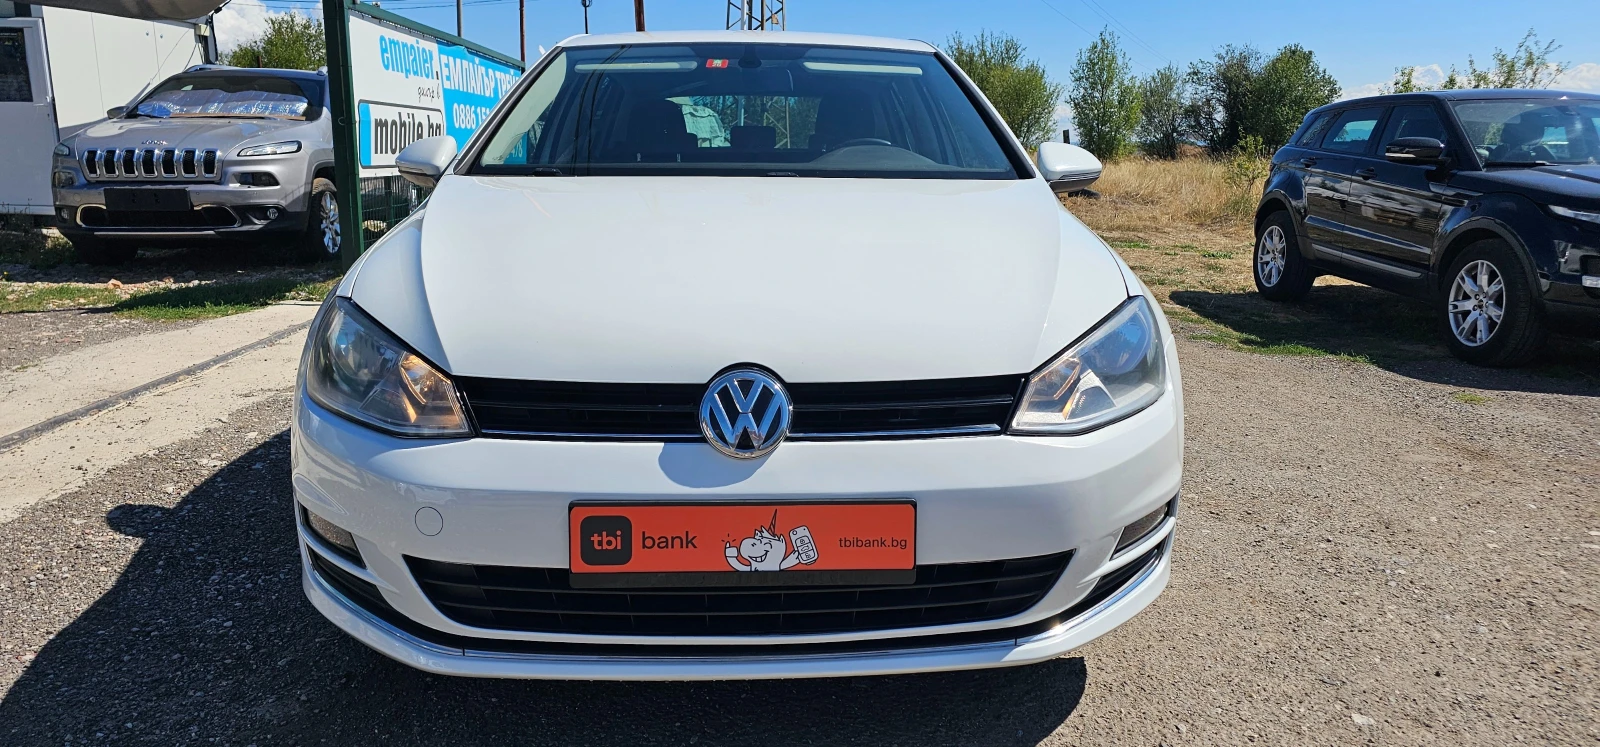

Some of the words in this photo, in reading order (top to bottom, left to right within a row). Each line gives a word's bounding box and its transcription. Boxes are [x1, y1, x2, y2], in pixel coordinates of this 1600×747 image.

[440, 54, 495, 98] ЕМПАЙЪР
[453, 103, 476, 129] 0886
[591, 531, 622, 550] tbi
[642, 531, 697, 549] bank
[838, 537, 907, 551] tbibank.bg
